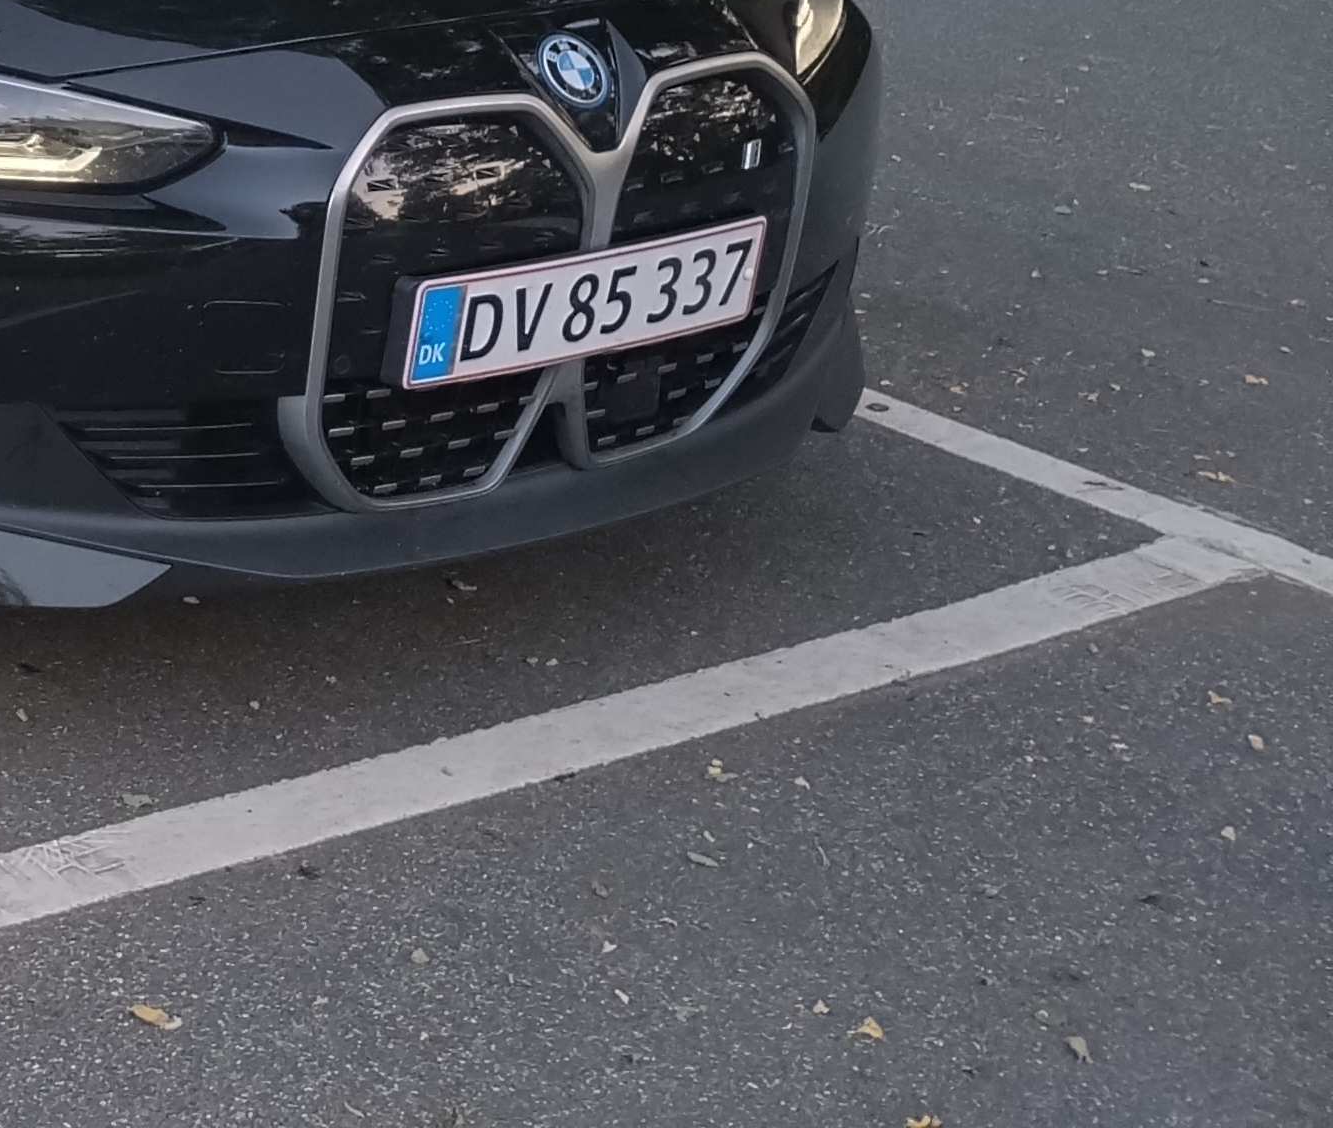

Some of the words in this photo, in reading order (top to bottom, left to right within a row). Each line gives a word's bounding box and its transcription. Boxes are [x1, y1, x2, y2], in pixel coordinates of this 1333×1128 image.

[460, 282, 554, 362] DV
[562, 265, 638, 343] 85
[646, 238, 754, 324] 337
[418, 342, 445, 367] DK
